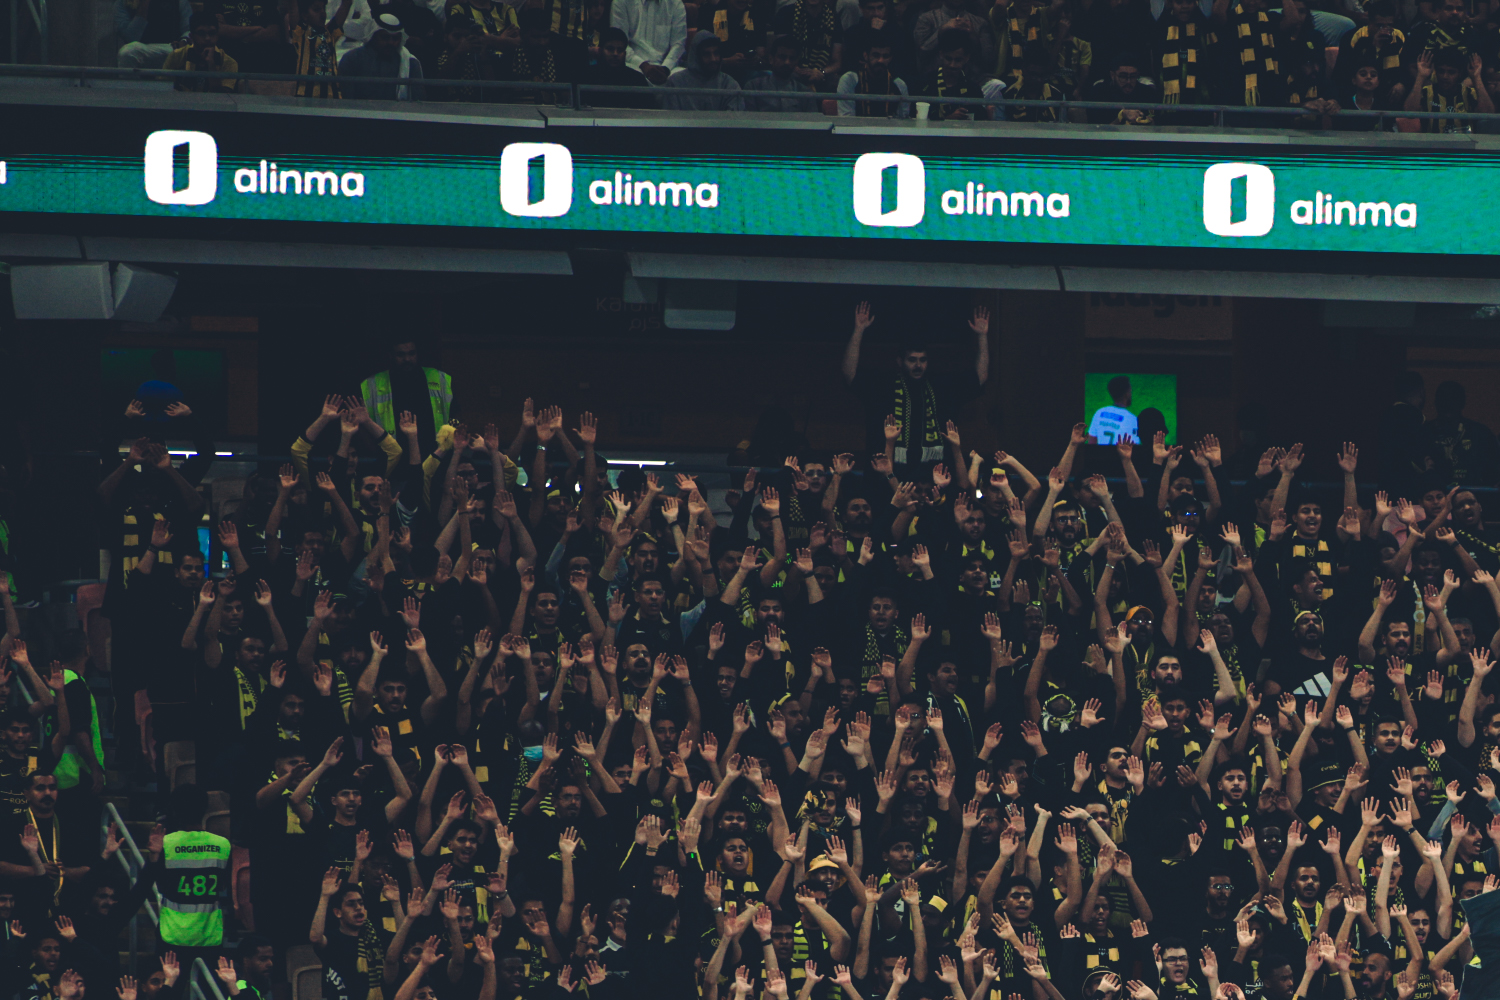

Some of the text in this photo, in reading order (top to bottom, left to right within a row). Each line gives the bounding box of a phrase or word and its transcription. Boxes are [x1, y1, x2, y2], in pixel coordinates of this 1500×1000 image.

[234, 160, 364, 196] alinma
[589, 171, 718, 207] alinma
[941, 182, 1070, 218] alinma
[1291, 191, 1417, 228] alinma
[175, 844, 221, 855] ORGANIZER
[177, 875, 218, 896] 482
